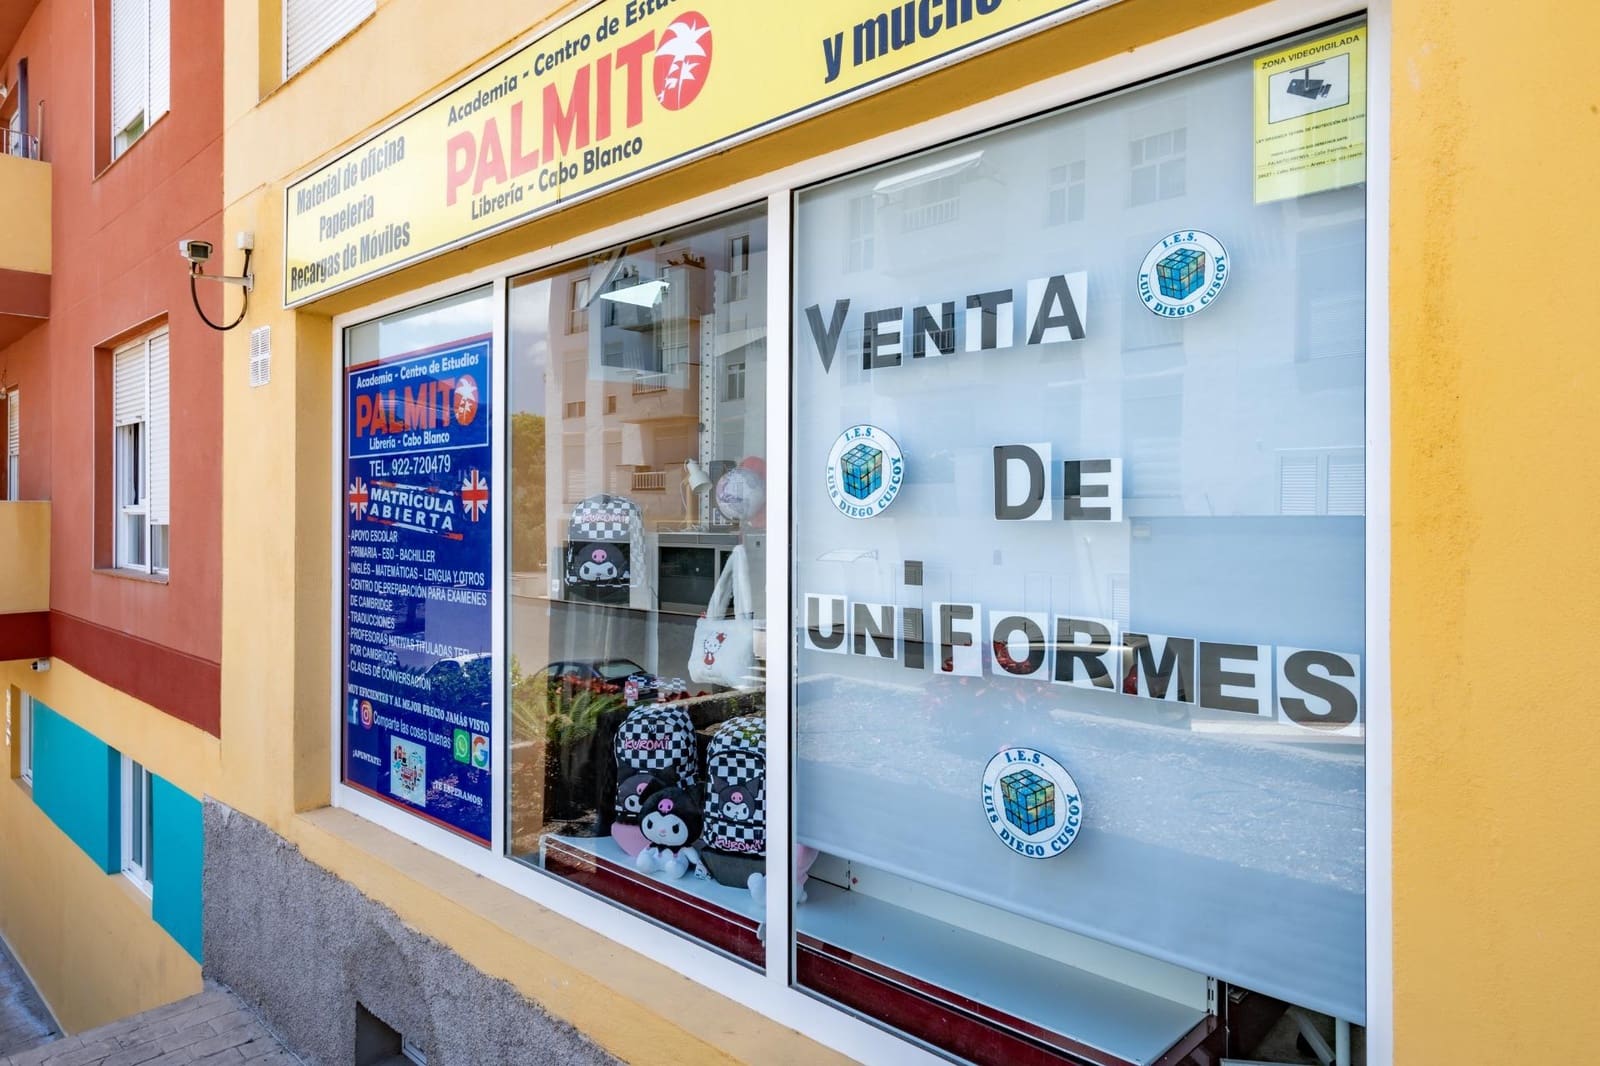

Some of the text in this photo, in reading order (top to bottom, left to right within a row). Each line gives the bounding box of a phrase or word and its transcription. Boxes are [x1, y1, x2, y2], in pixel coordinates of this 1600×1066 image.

[448, 74, 518, 127] Academia
[534, 32, 591, 77] Centro
[596, 15, 619, 42] de
[626, 0, 677, 27] Estu
[822, 31, 844, 84] y
[1262, 34, 1360, 70] ZONA VIDEOVIGILADA
[297, 135, 405, 216] Material de oficina
[471, 178, 523, 220] Librería
[538, 159, 578, 192] Cabo
[583, 136, 643, 176] Blanco
[1162, 232, 1197, 248] I.E.S.
[291, 222, 410, 292] Recargas de Móviles
[1140, 255, 1226, 316] LUIS DIEGO CUSCOY
[804, 274, 1087, 375] VENTA
[356, 371, 393, 389] Academia
[400, 364, 427, 380] Centro
[429, 360, 440, 374] de
[442, 352, 479, 371] Estudios
[369, 435, 396, 450] Librería
[403, 433, 422, 447] Cabo
[423, 430, 450, 445] Blanco
[845, 427, 875, 441] I.E.S.
[369, 454, 451, 477] TEL. 922-720479
[828, 457, 902, 517] LUIS DIEGO CUSCOY
[993, 444, 1112, 521] DE
[370, 487, 455, 514] MATRÍCULA
[370, 503, 453, 531] ABIERTA
[351, 530, 398, 543] APOYO ESCOLAR
[351, 546, 377, 559] PRIMARIA
[381, 548, 395, 560] ESO
[400, 548, 436, 562] BACHILLER
[351, 559, 371, 575] INGLÉS
[375, 563, 418, 580] MATEMÁTICAS
[424, 568, 452, 583] LENGUA
[453, 569, 459, 583] Y
[459, 571, 485, 586] OTROS
[350, 595, 393, 611] DE CAMBRIDGE
[351, 579, 374, 593] CENTRO
[374, 580, 383, 593] DE
[383, 581, 427, 599] PREPARACIÓN
[428, 587, 446, 601] PARA
[350, 611, 395, 629] TRADUCCIONES
[350, 628, 388, 646] PROFESORAS
[388, 635, 415, 651] NATIVAS
[415, 640, 453, 658] TITULADAS
[350, 643, 397, 665] POR CAMBRIDGE
[351, 661, 431, 690] CLASES DE CONVERSACIÓN
[359, 687, 389, 704] EFICIENTES
[389, 695, 394, 705] Y
[394, 697, 402, 708] AL
[402, 698, 422, 713] MEJOR
[422, 703, 445, 720] PRECIO
[445, 711, 468, 727] JAMÁS
[468, 718, 490, 733] VISTO
[373, 711, 452, 749] Comparte las cosas buenas
[1005, 750, 1045, 767] I.E.S.
[443, 783, 483, 807] ESPERAMOS!
[983, 783, 1080, 856] LUIS DIEGO CUSCOY
